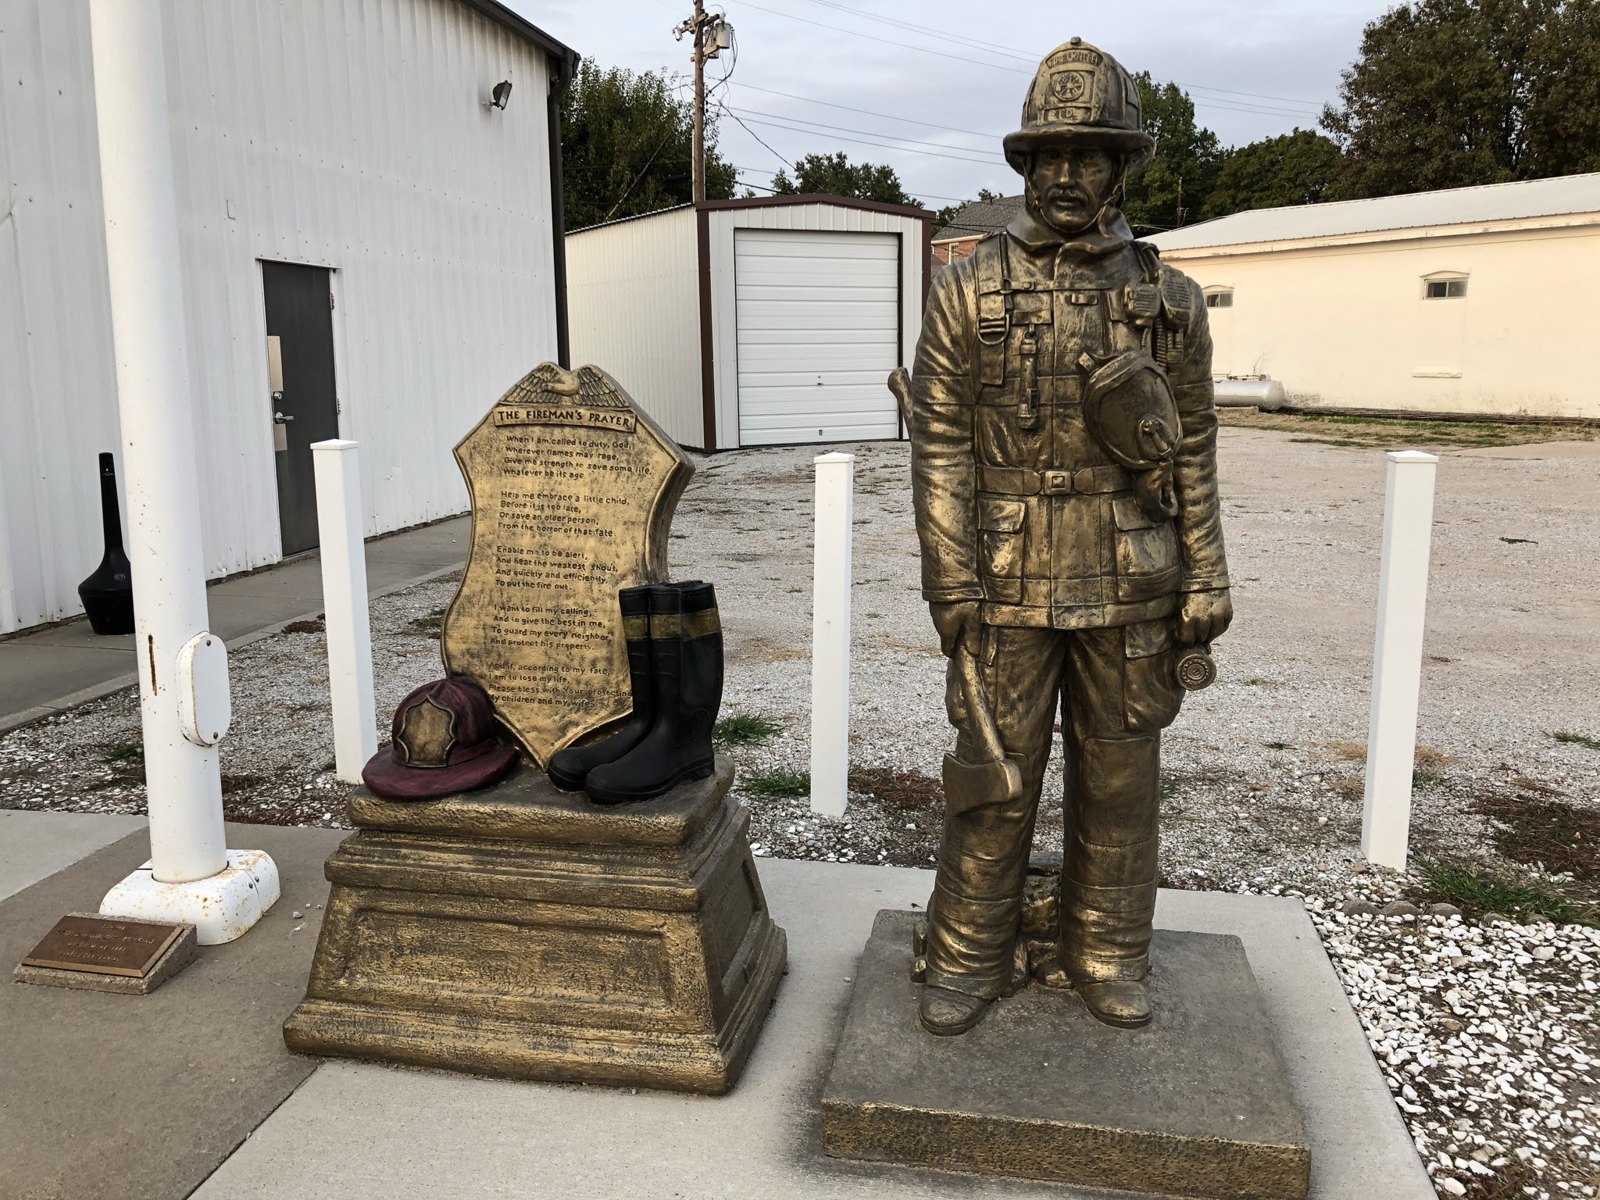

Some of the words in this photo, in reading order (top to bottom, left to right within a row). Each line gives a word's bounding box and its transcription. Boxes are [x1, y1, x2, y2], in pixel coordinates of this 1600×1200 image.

[498, 411, 520, 421] THE
[526, 409, 582, 420] FIREMAN'S
[589, 411, 630, 427] PRAYER
[506, 435, 529, 444] When
[551, 438, 576, 446] called
[505, 446, 544, 456] Wherever
[546, 449, 574, 458] flames
[504, 456, 522, 465] Give
[539, 460, 573, 469] strength
[587, 463, 607, 471] save
[503, 469, 542, 477] Whatever
[556, 470, 567, 478] its
[501, 491, 520, 499] Help
[536, 492, 573, 501] embrace
[583, 495, 604, 504] little
[500, 500, 527, 508] Before
[537, 503, 545, 511] is
[499, 511, 509, 519] Or
[544, 514, 567, 522] older
[498, 522, 519, 530] From
[521, 523, 534, 532] the
[536, 525, 562, 533] horror
[573, 527, 592, 535] that
[496, 545, 524, 555] Enable
[495, 556, 511, 564] And
[513, 557, 533, 566] hear
[533, 558, 547, 567] the
[549, 561, 586, 571] weakest
[495, 568, 511, 576] And
[513, 569, 543, 579] quickly
[545, 571, 560, 579] and
[507, 580, 521, 588] put
[522, 580, 535, 589] the
[536, 581, 552, 589] fire
[499, 604, 519, 612] want
[545, 608, 558, 616] my
[493, 615, 509, 623] And
[541, 617, 555, 626] the
[557, 618, 576, 627] best
[577, 619, 586, 627] in
[491, 626, 501, 634] To
[503, 627, 528, 636] guard
[529, 630, 542, 638] my
[544, 630, 568, 639] every
[508, 639, 539, 647] protect
[540, 640, 553, 649] his
[489, 662, 505, 670] And
[518, 664, 559, 674] according
[573, 667, 585, 675] my
[519, 674, 537, 682] lose
[540, 676, 552, 684] my
[488, 683, 516, 693] Please
[518, 685, 540, 693] bless
[542, 686, 561, 694] with
[562, 686, 584, 695] Your
[501, 695, 536, 704] children
[537, 697, 553, 705] and
